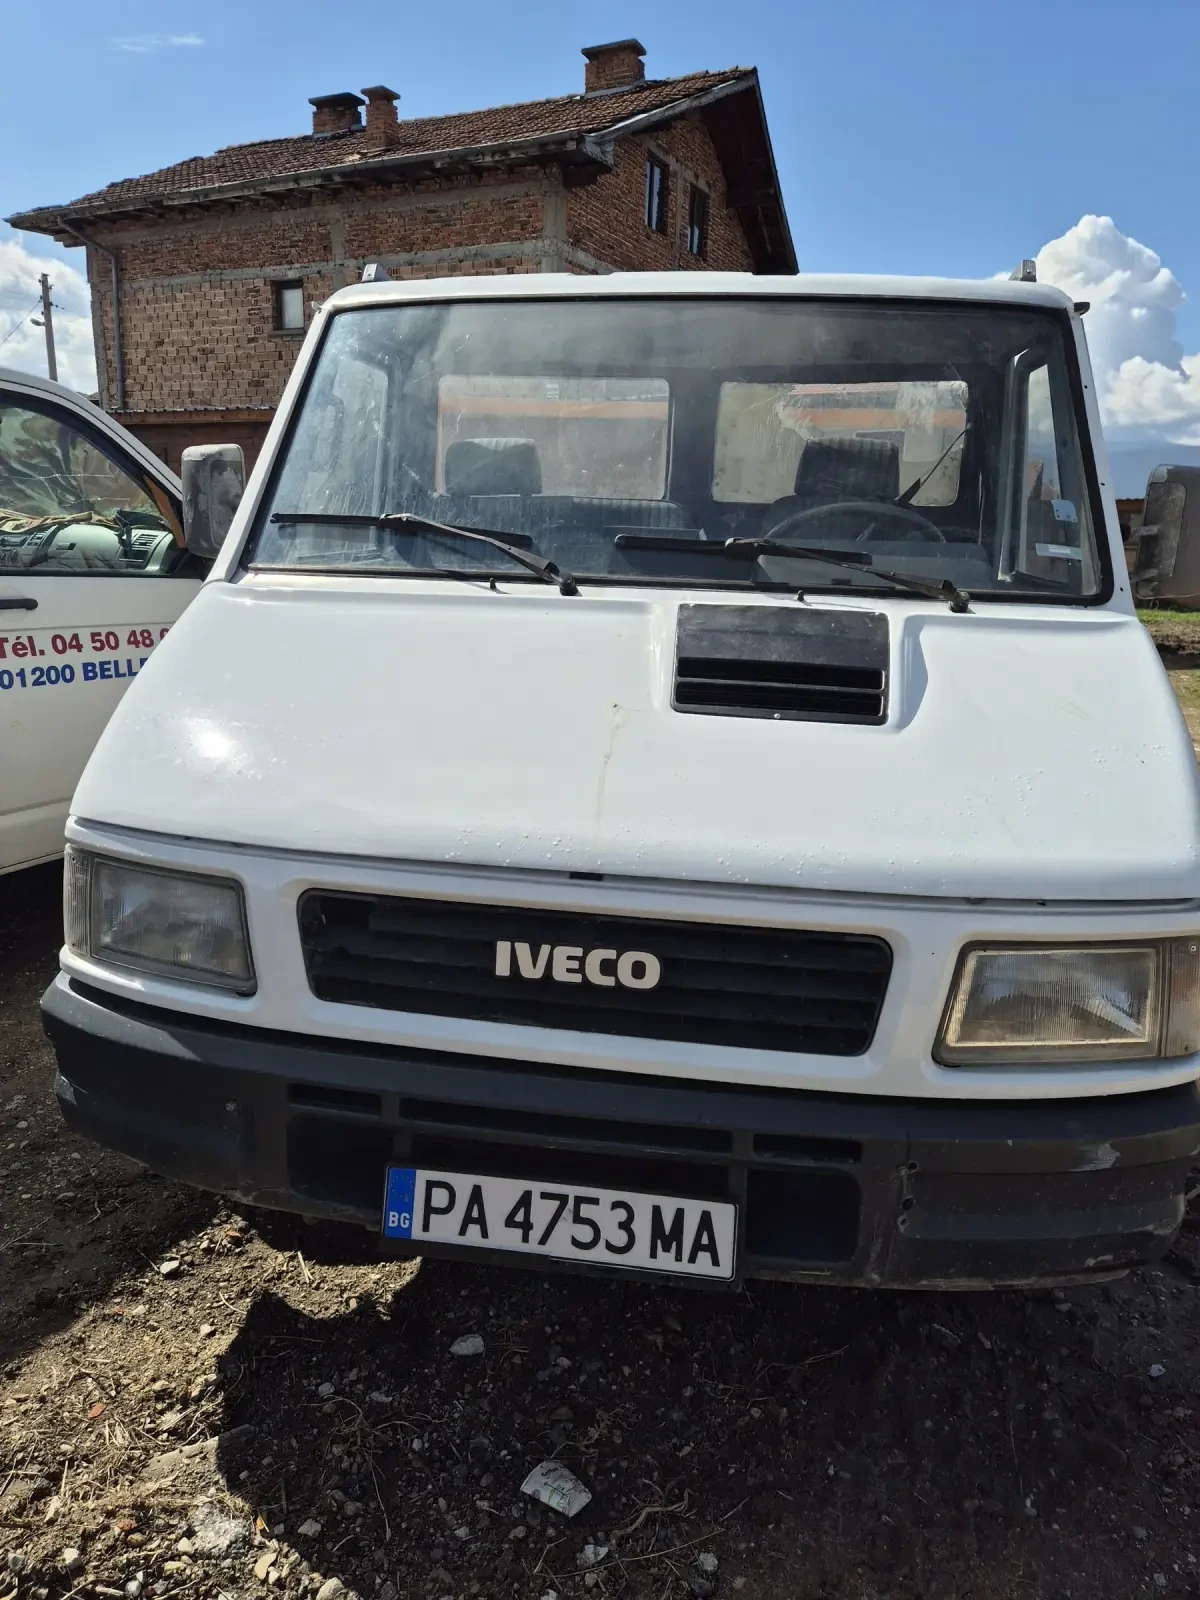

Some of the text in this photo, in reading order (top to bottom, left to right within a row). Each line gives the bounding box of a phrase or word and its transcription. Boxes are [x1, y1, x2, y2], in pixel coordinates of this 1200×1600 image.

[0, 635, 46, 659] Tél.
[51, 633, 84, 655] 04
[90, 631, 120, 652] 50
[126, 629, 155, 649] 48
[0, 664, 76, 690] 01200
[495, 940, 661, 989] IVECO
[388, 1211, 410, 1229] BG
[421, 1179, 721, 1268] PA 4753 MA
